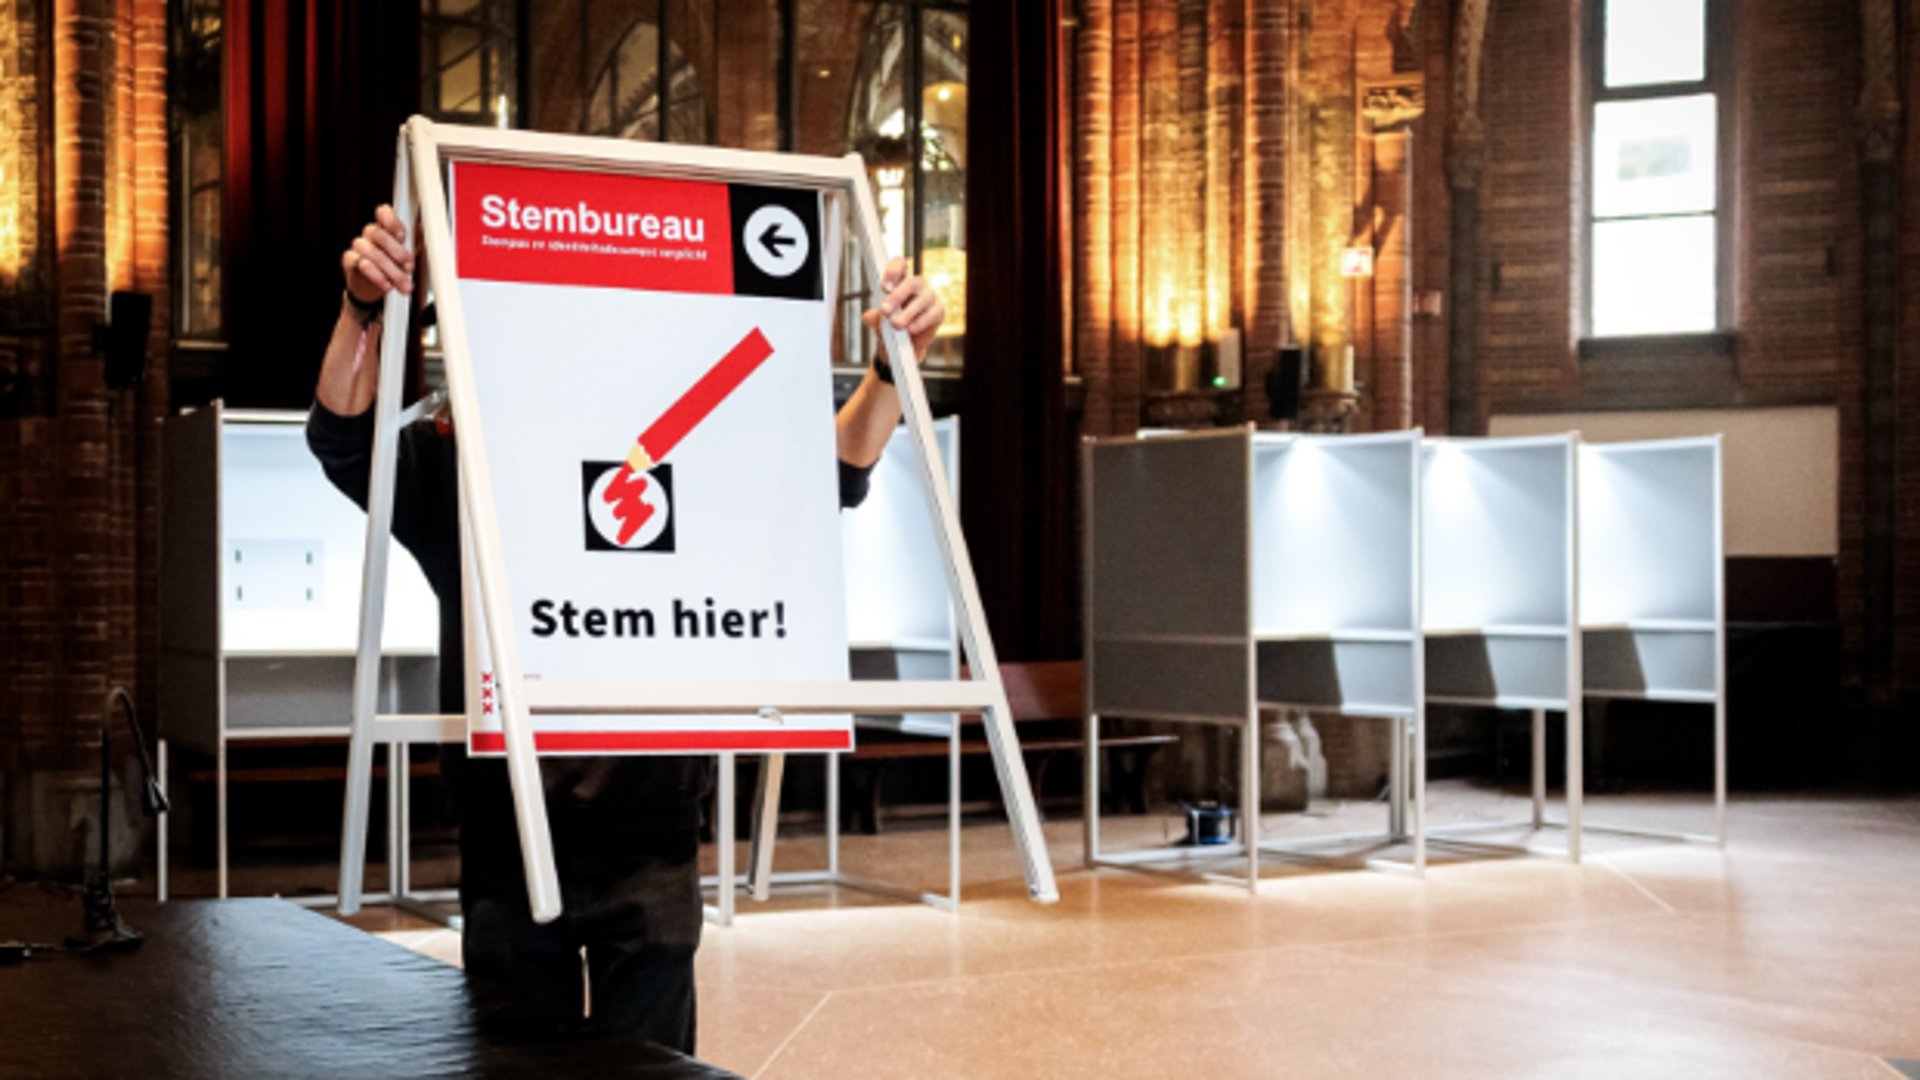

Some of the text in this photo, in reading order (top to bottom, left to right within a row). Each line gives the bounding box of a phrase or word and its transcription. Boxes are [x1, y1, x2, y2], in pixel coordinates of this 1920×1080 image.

[480, 194, 705, 242] Stembureau
[531, 597, 787, 638] Stem hier!
